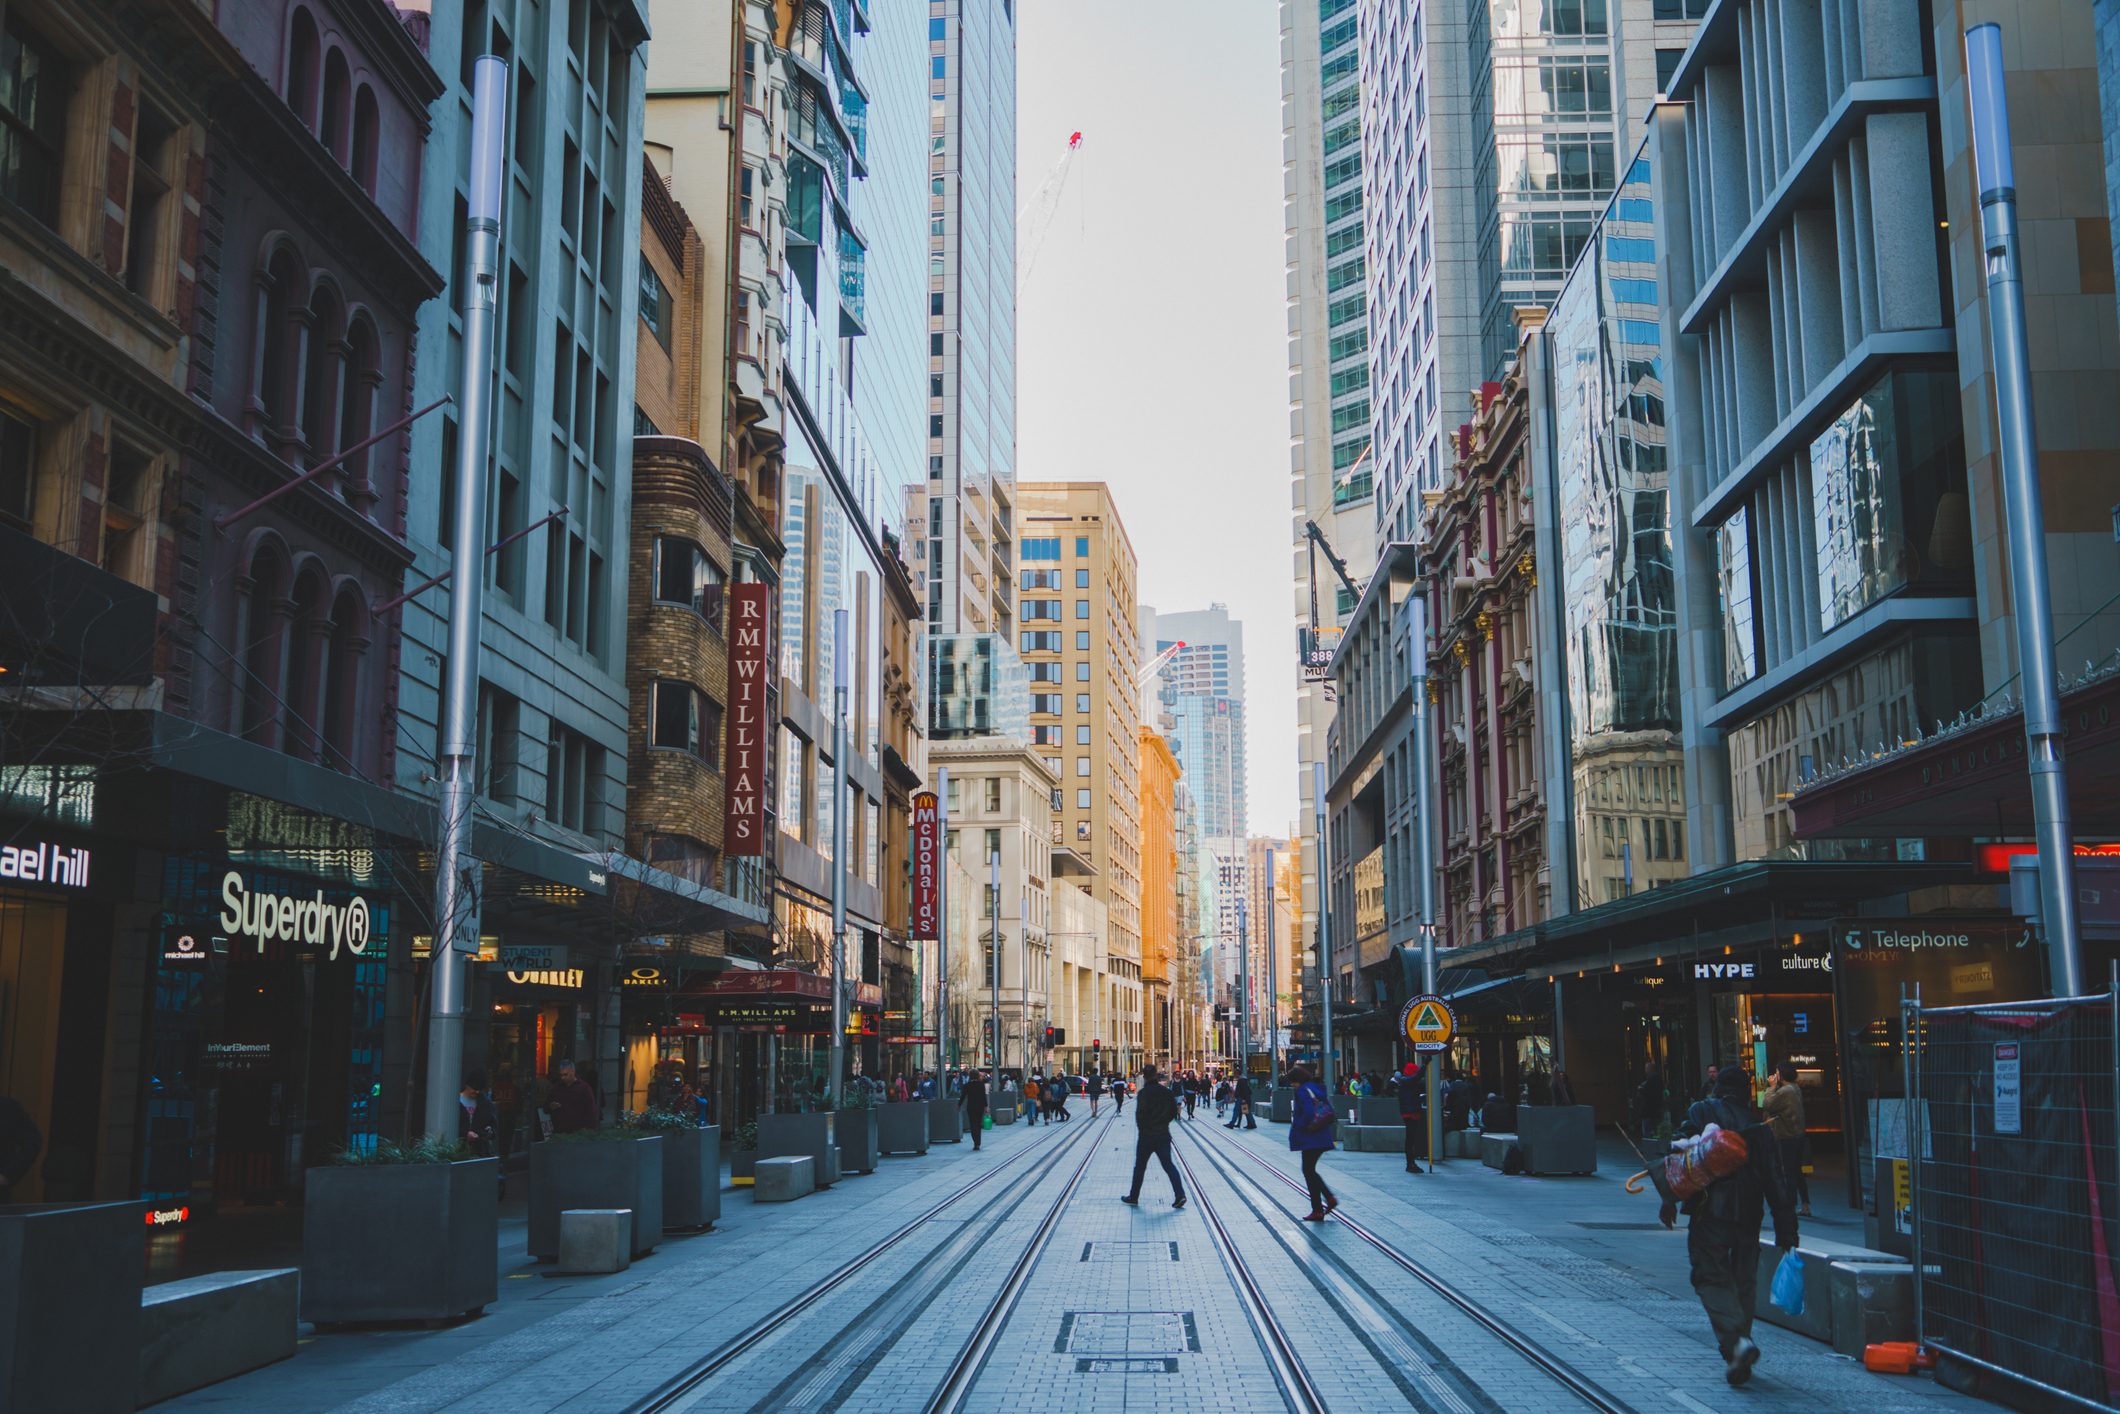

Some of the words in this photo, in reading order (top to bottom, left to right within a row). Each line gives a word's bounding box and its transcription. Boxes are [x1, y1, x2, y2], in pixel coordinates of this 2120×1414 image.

[1311, 650, 1333, 662] 388
[1922, 735, 2023, 784] DYMOCKS
[51, 844, 89, 887] hill
[916, 808, 935, 932] McDonald's
[454, 926, 478, 944] ONLY
[1872, 930, 1969, 953] Telephone
[503, 947, 552, 957] STUDENT
[1782, 953, 1820, 970] culture
[1694, 963, 1755, 979] HYPE
[1420, 1030, 1437, 1042] UGG
